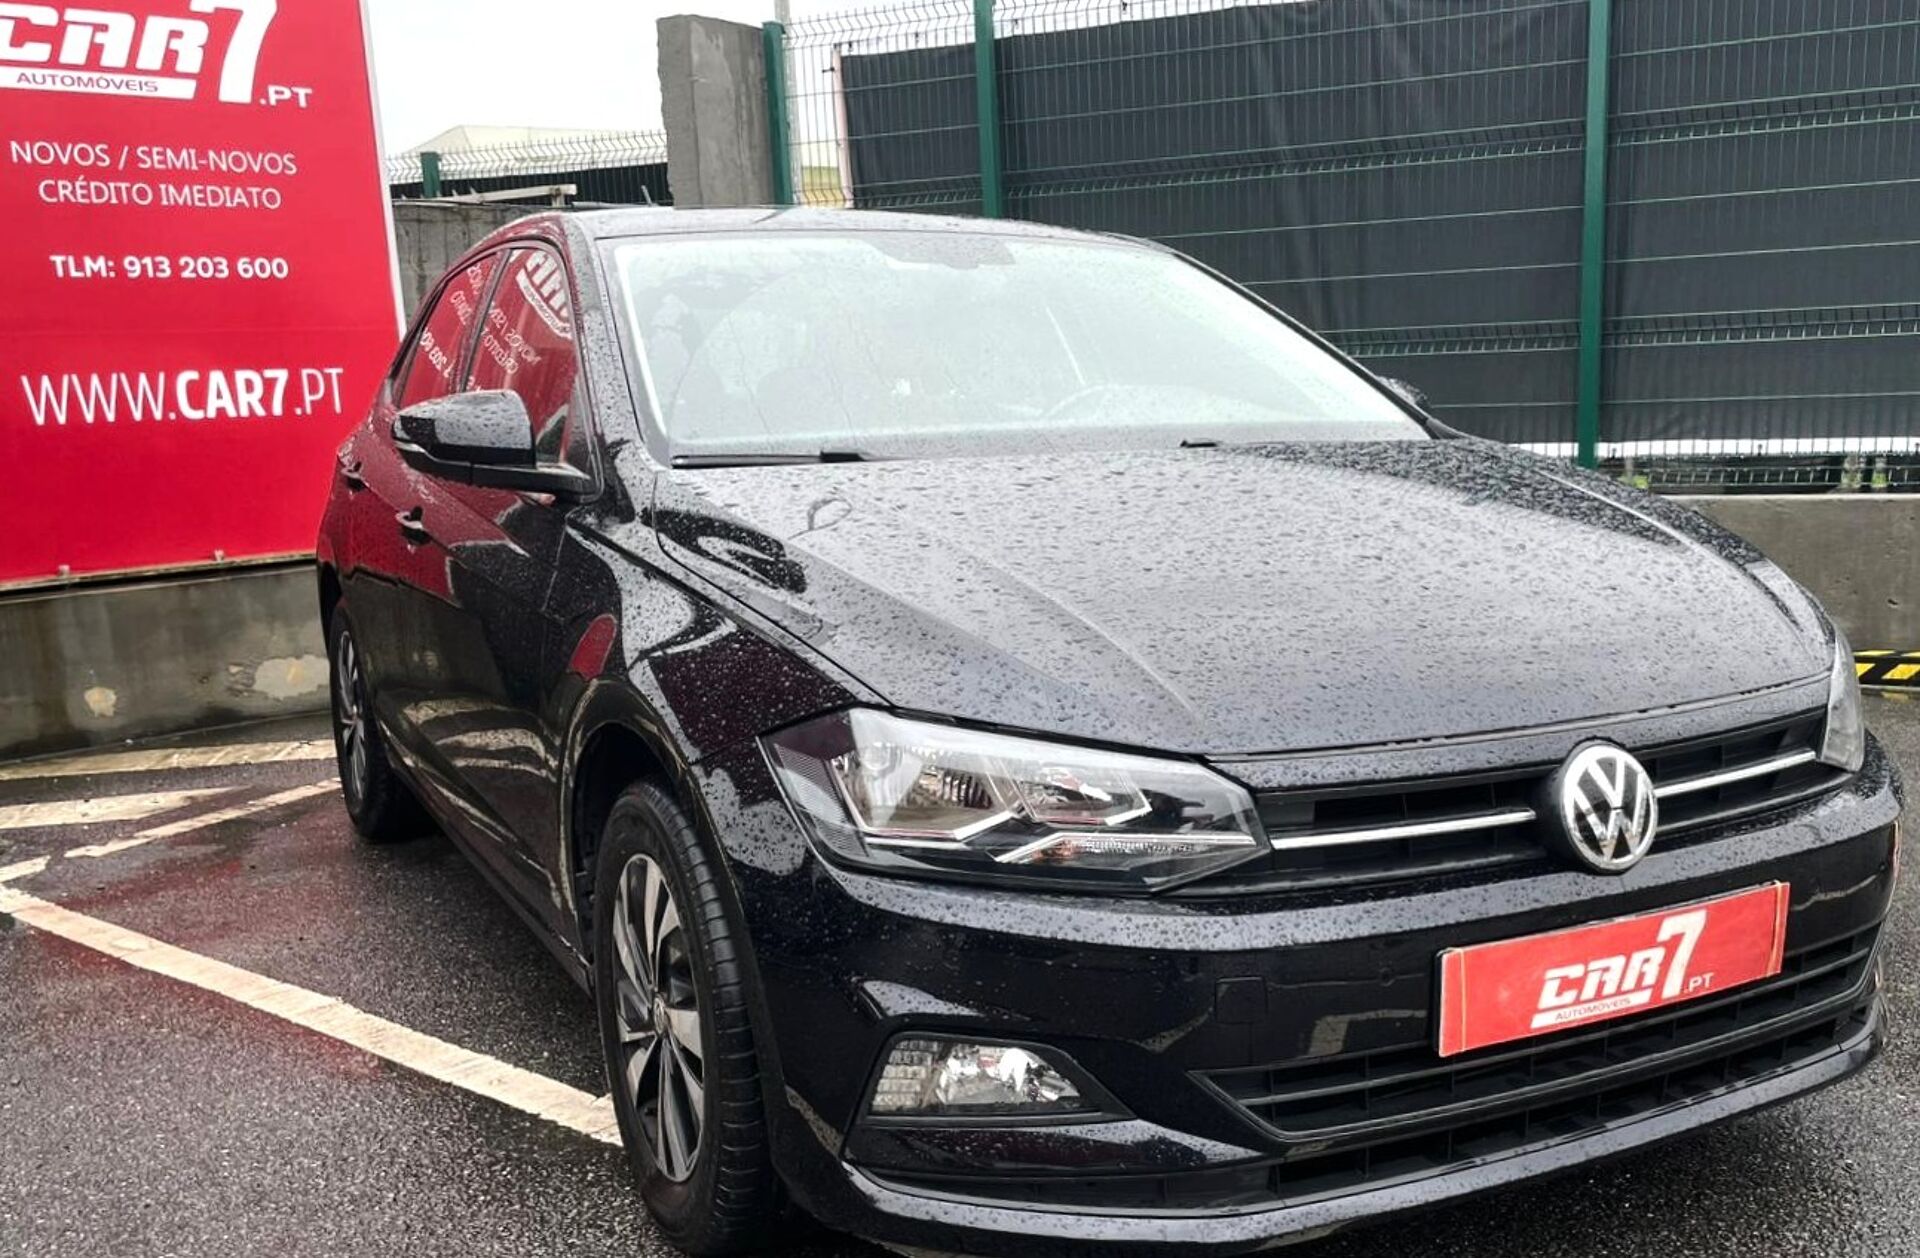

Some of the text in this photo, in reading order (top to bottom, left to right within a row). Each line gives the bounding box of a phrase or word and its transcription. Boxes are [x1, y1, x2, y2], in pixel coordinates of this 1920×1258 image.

[16, 71, 159, 94] AUTOMÓVEIS
[11, 141, 110, 166] NOVOS
[136, 147, 297, 175] SEMI-NOVOS
[38, 176, 282, 210] CRÉDITO IMEDIATO
[49, 254, 290, 280] TLM: 913 203 600
[21, 368, 344, 426] WWW.CAR7.PT
